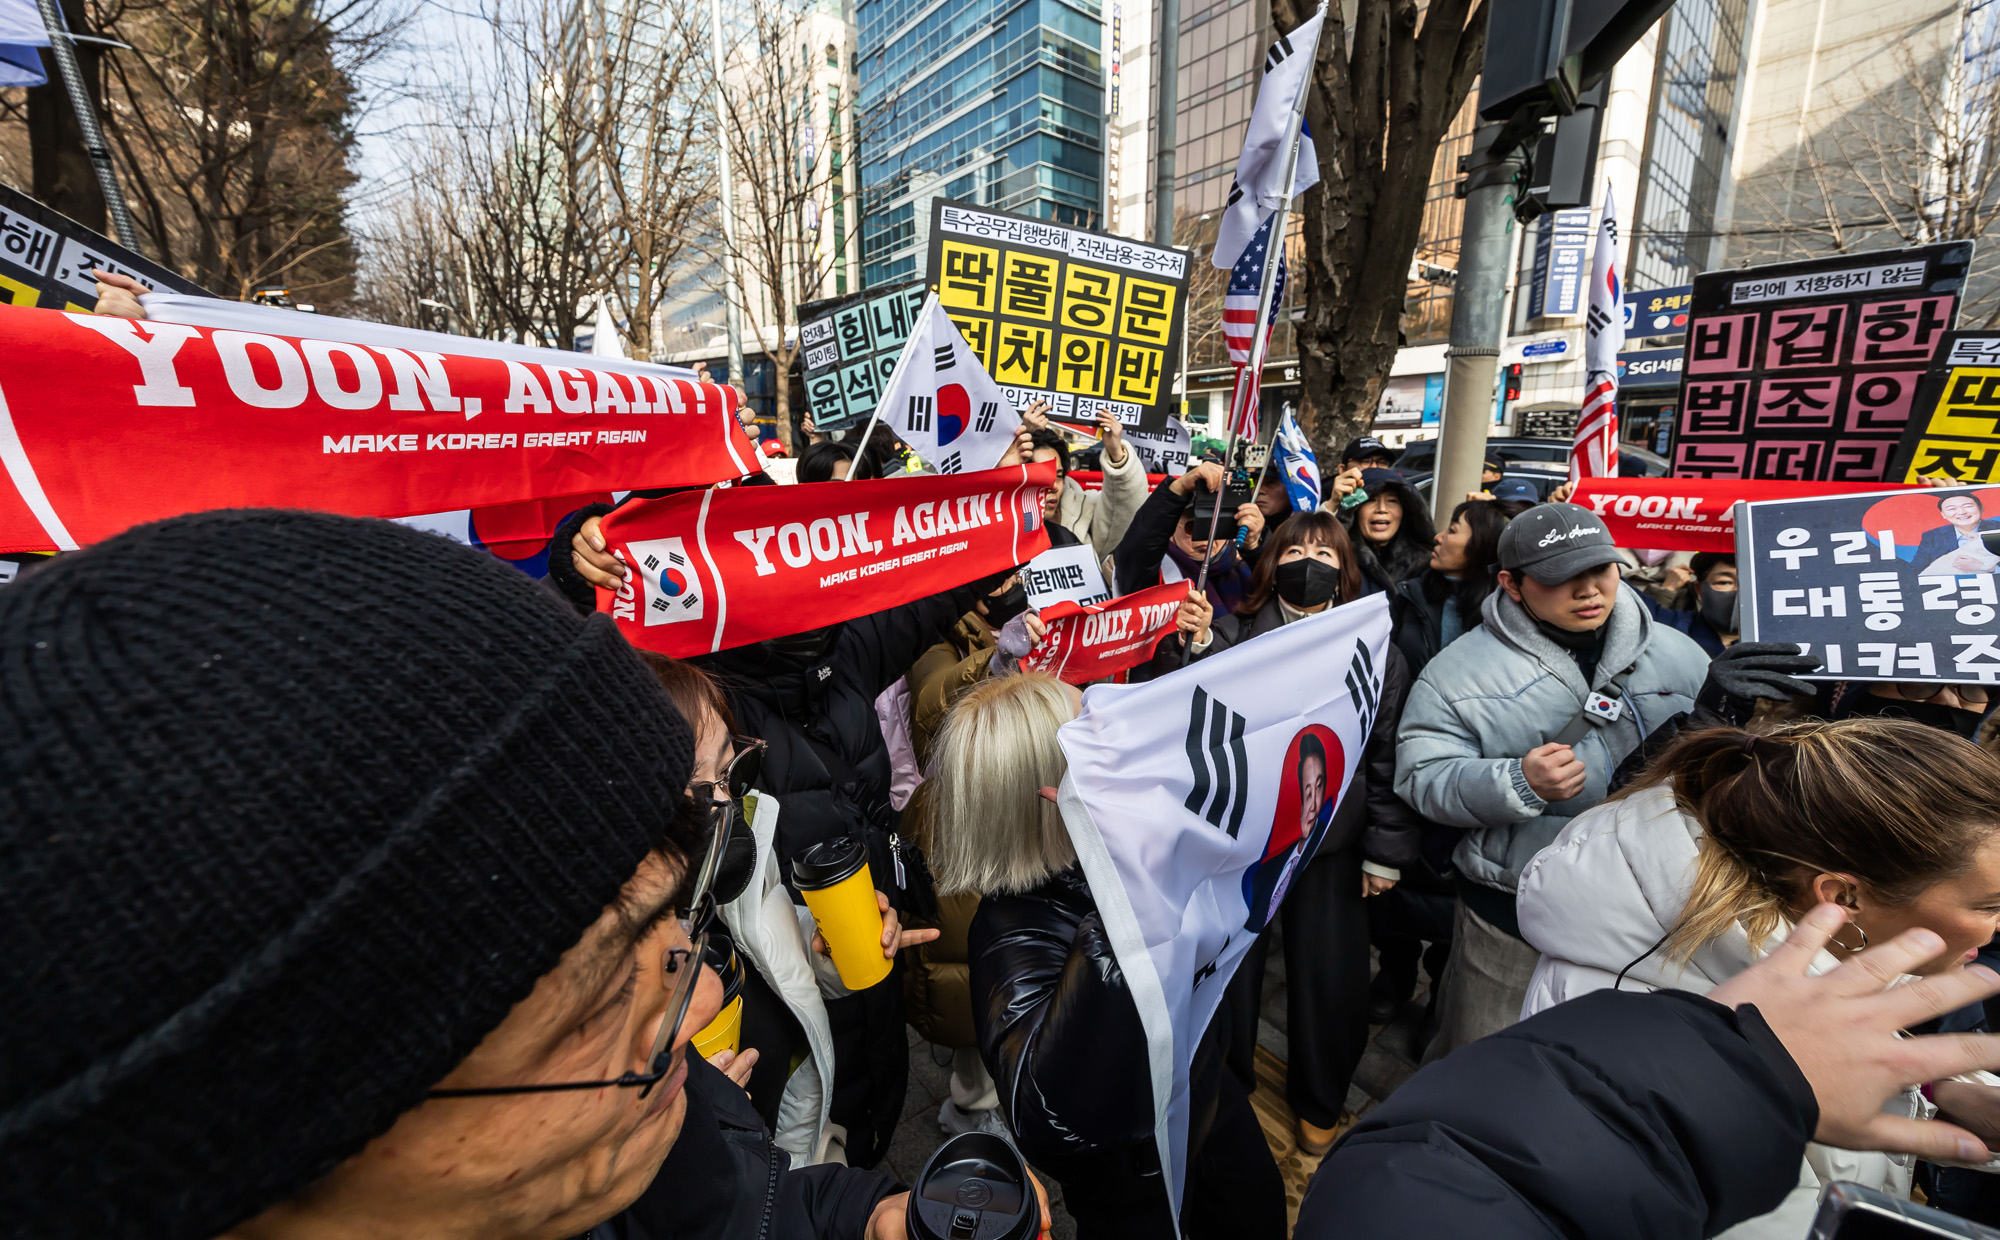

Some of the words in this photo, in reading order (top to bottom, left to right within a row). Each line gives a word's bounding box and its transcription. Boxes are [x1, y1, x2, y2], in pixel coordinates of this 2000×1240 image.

[946, 249, 1168, 339] 딱풀공문
[1734, 281, 1786, 301] 불의에
[1794, 271, 1871, 294] 저항하지
[1881, 265, 1923, 285] 않는
[1693, 300, 1944, 369] 비겁한
[61, 311, 482, 421] YOON,
[504, 360, 707, 415] AGAIN!
[323, 434, 419, 454] MAKE
[426, 433, 517, 451] KOREA
[523, 431, 592, 448] GREAT
[596, 429, 647, 445] AGAIN
[1588, 493, 1708, 522] YOON,
[1636, 522, 1674, 531] MAKE
[1675, 524, 1722, 533] KOREA
[733, 511, 883, 577] YOON,
[892, 490, 1004, 547] AGAIN!
[1770, 527, 1896, 570] 우리
[820, 568, 858, 588] MAKE
[860, 558, 900, 578] KOREA
[902, 549, 937, 567] GREAT
[939, 541, 968, 556] AGAIN
[1772, 572, 1999, 631] 대통령
[1082, 607, 1134, 648] ONLY,
